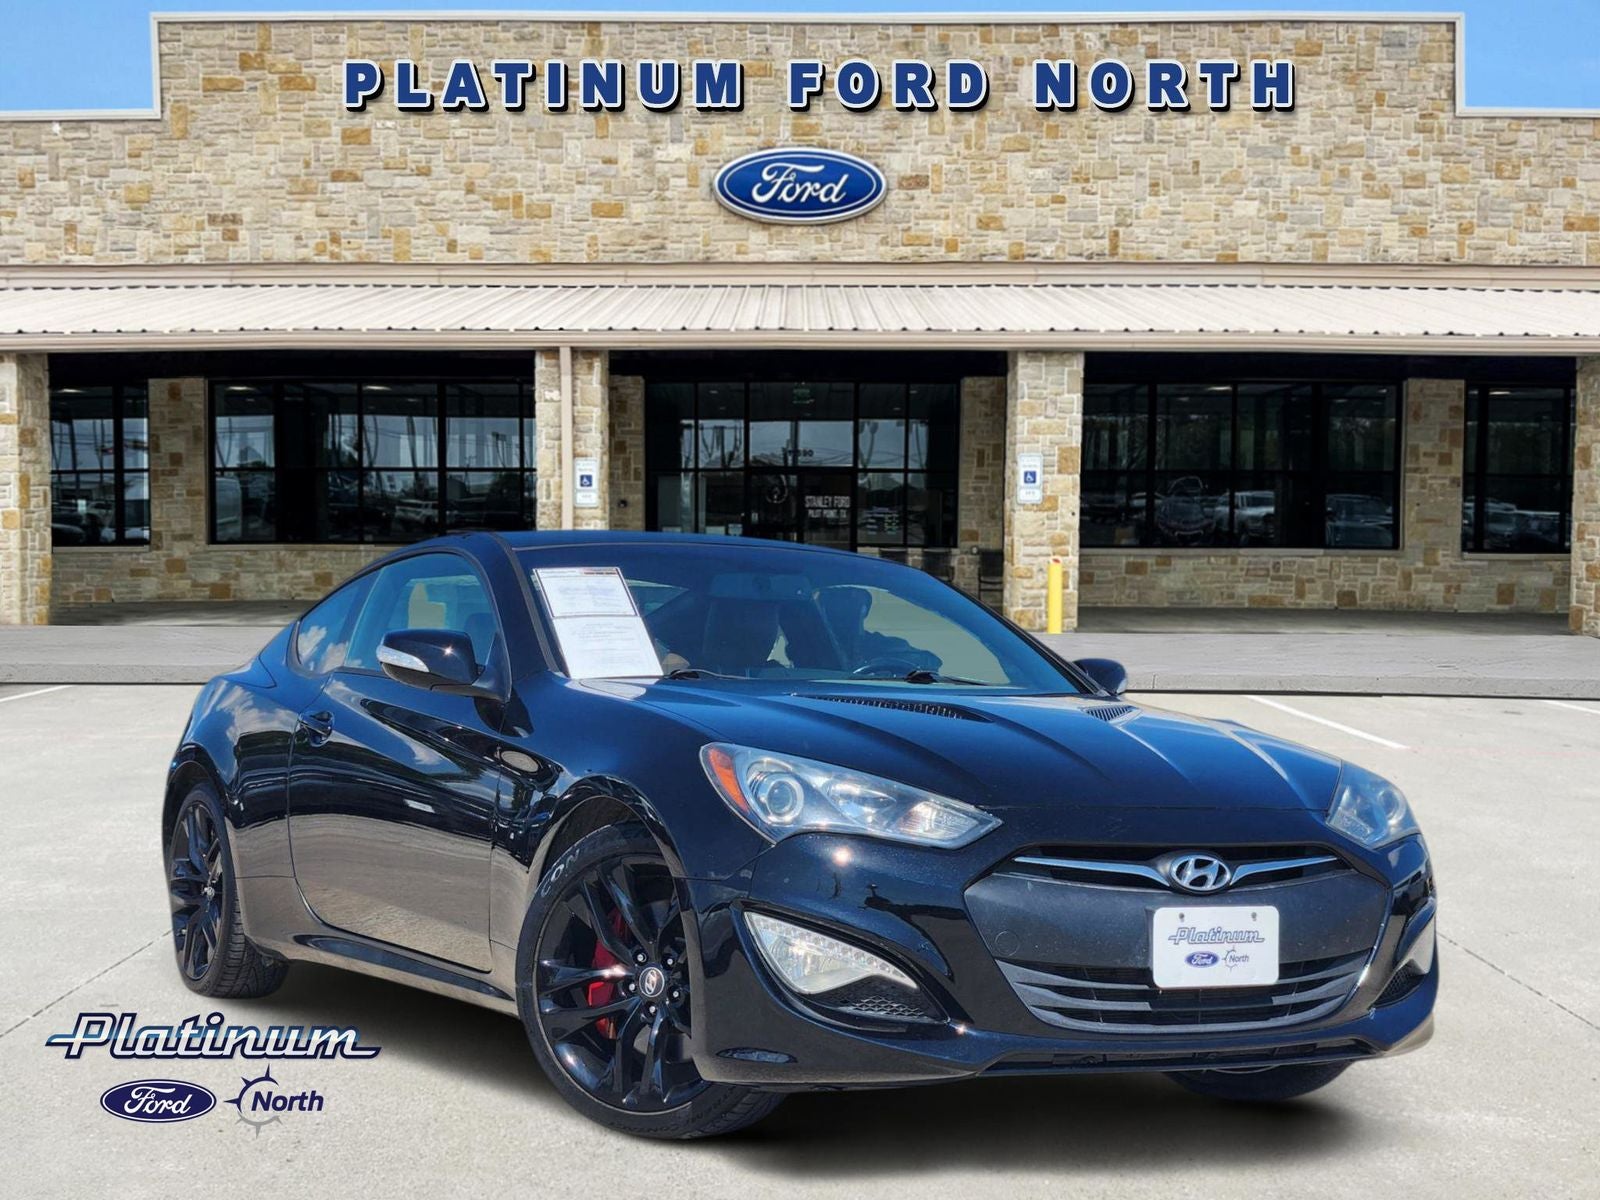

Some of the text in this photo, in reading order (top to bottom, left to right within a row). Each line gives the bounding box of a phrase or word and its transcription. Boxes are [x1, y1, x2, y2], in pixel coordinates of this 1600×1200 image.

[342, 58, 1295, 112] PLATINUM FORD NORTH
[1168, 926, 1265, 945] Platinum
[1229, 953, 1249, 963] North
